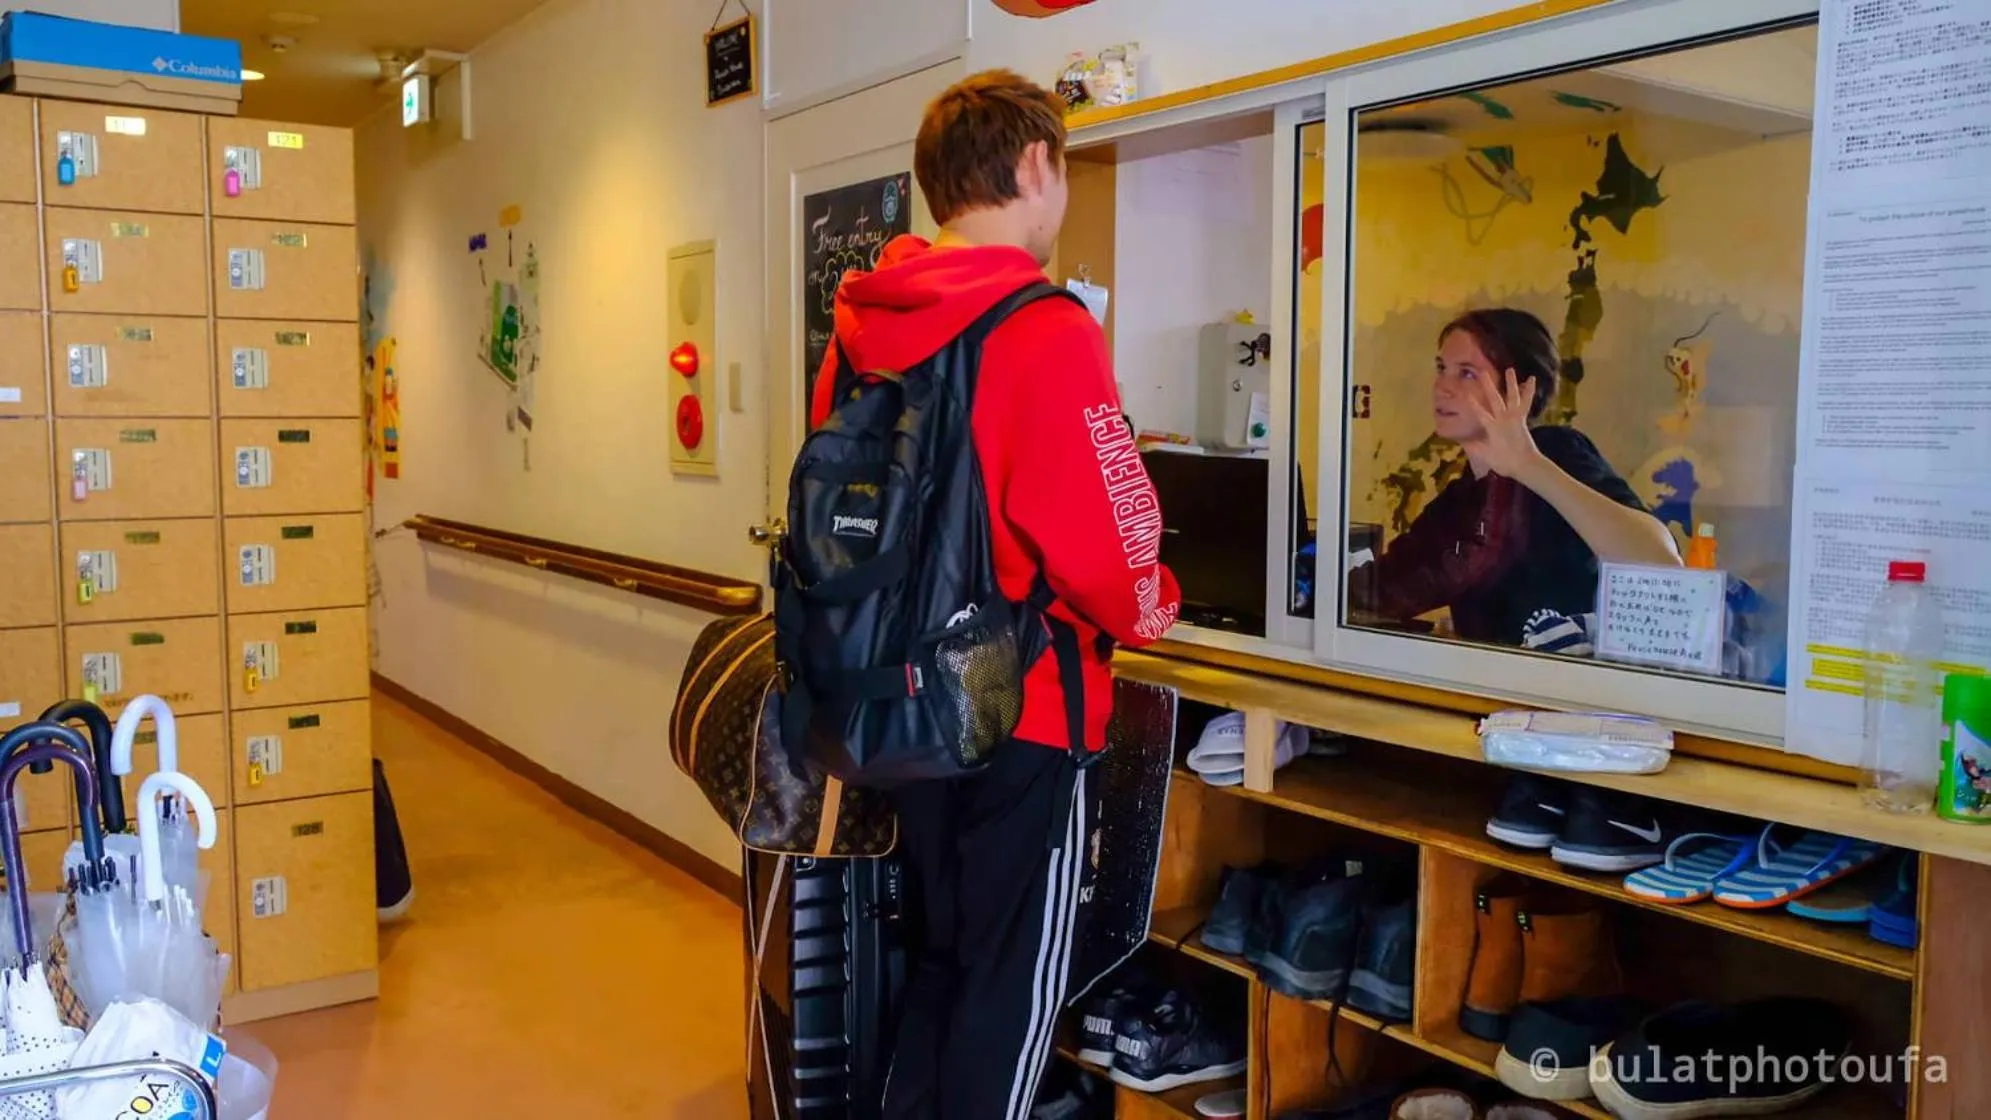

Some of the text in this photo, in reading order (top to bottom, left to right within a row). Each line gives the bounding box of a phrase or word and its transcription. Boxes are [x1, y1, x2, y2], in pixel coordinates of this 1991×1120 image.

[168, 59, 238, 79] Columbia
[812, 204, 891, 262] Free entry
[1084, 403, 1164, 569] AMBIENCE
[833, 515, 878, 535] THRASHER
